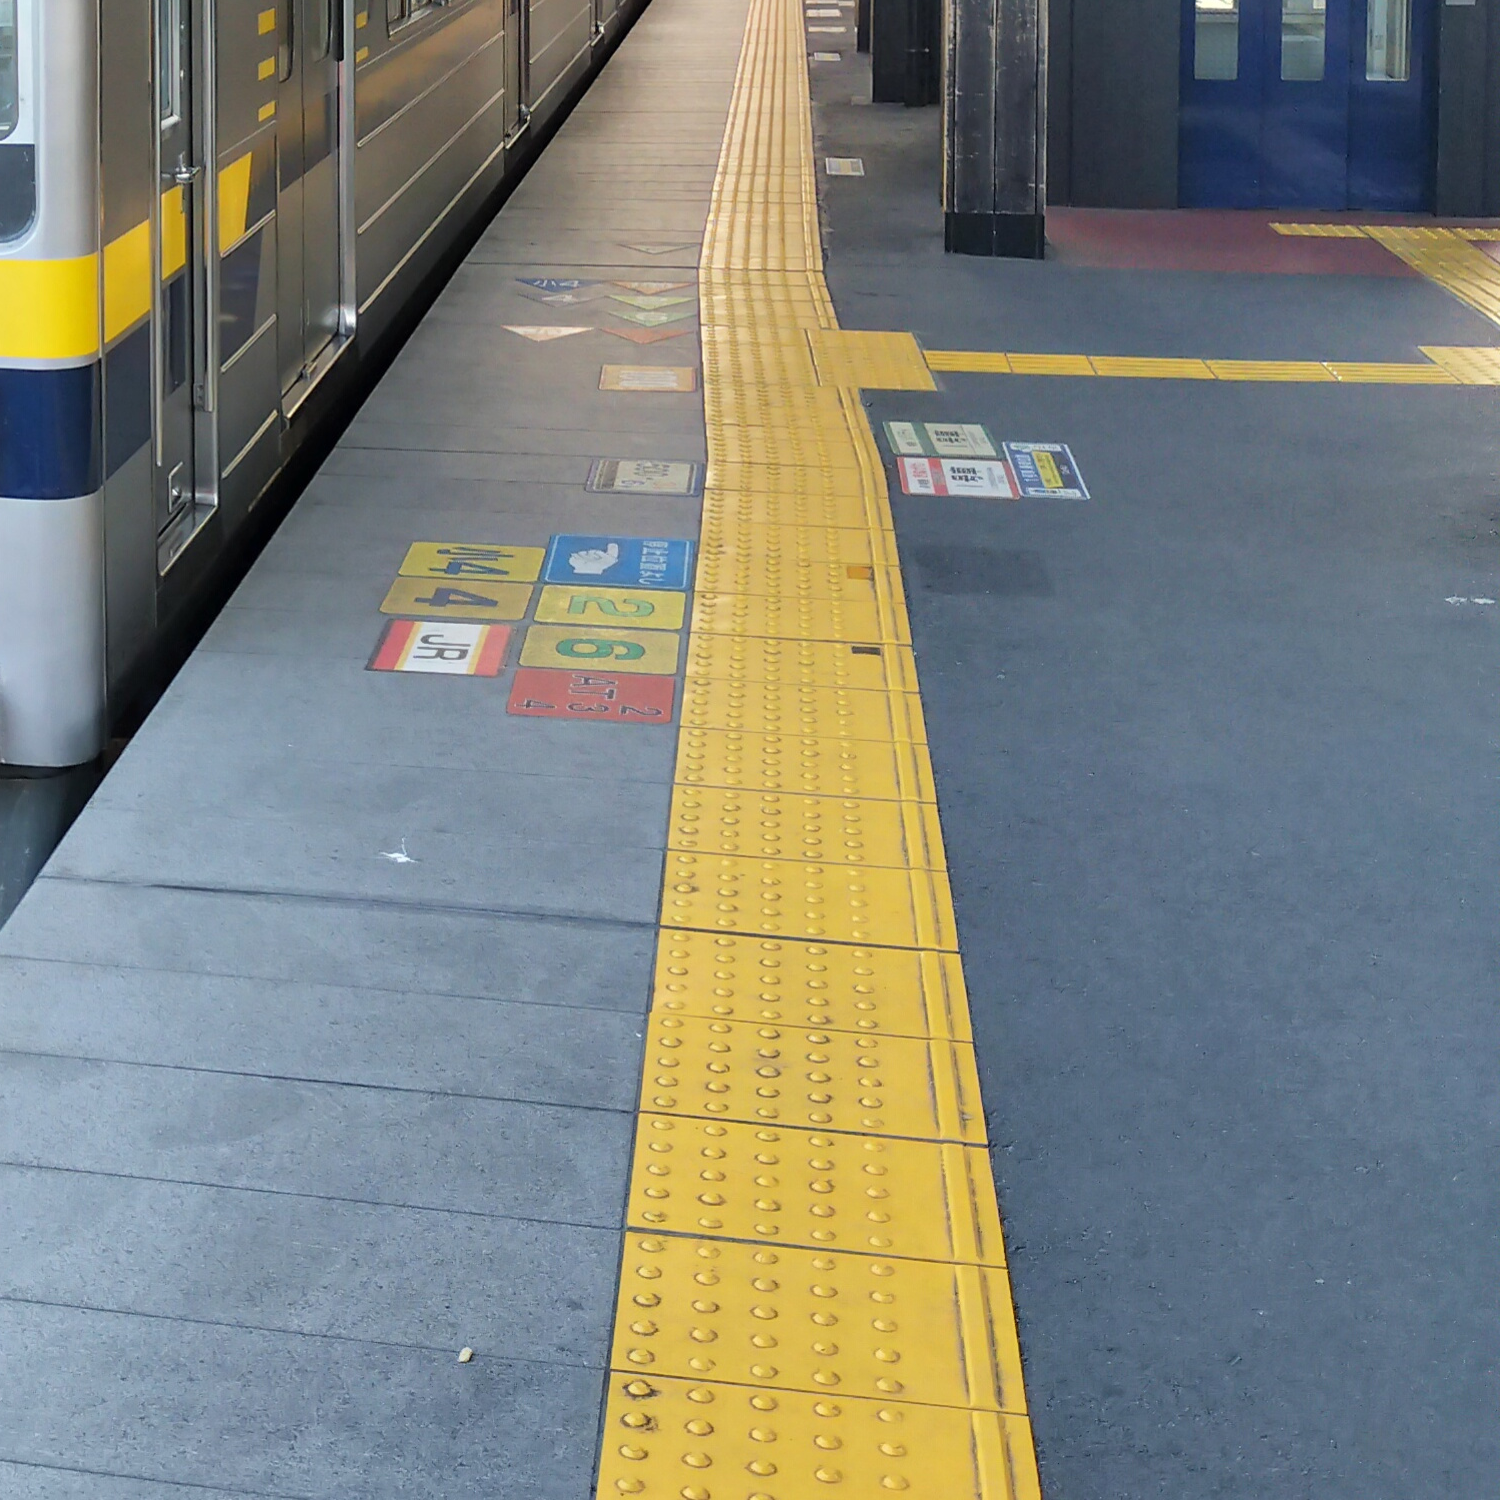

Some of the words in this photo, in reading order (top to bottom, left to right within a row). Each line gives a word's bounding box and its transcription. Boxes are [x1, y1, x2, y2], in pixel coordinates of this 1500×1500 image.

[414, 586, 499, 608] 4
[567, 594, 655, 617] 2
[413, 634, 471, 661] JR
[555, 638, 646, 661] 6
[514, 697, 557, 710] 4
[567, 701, 610, 713] 3
[619, 703, 663, 716] 2
